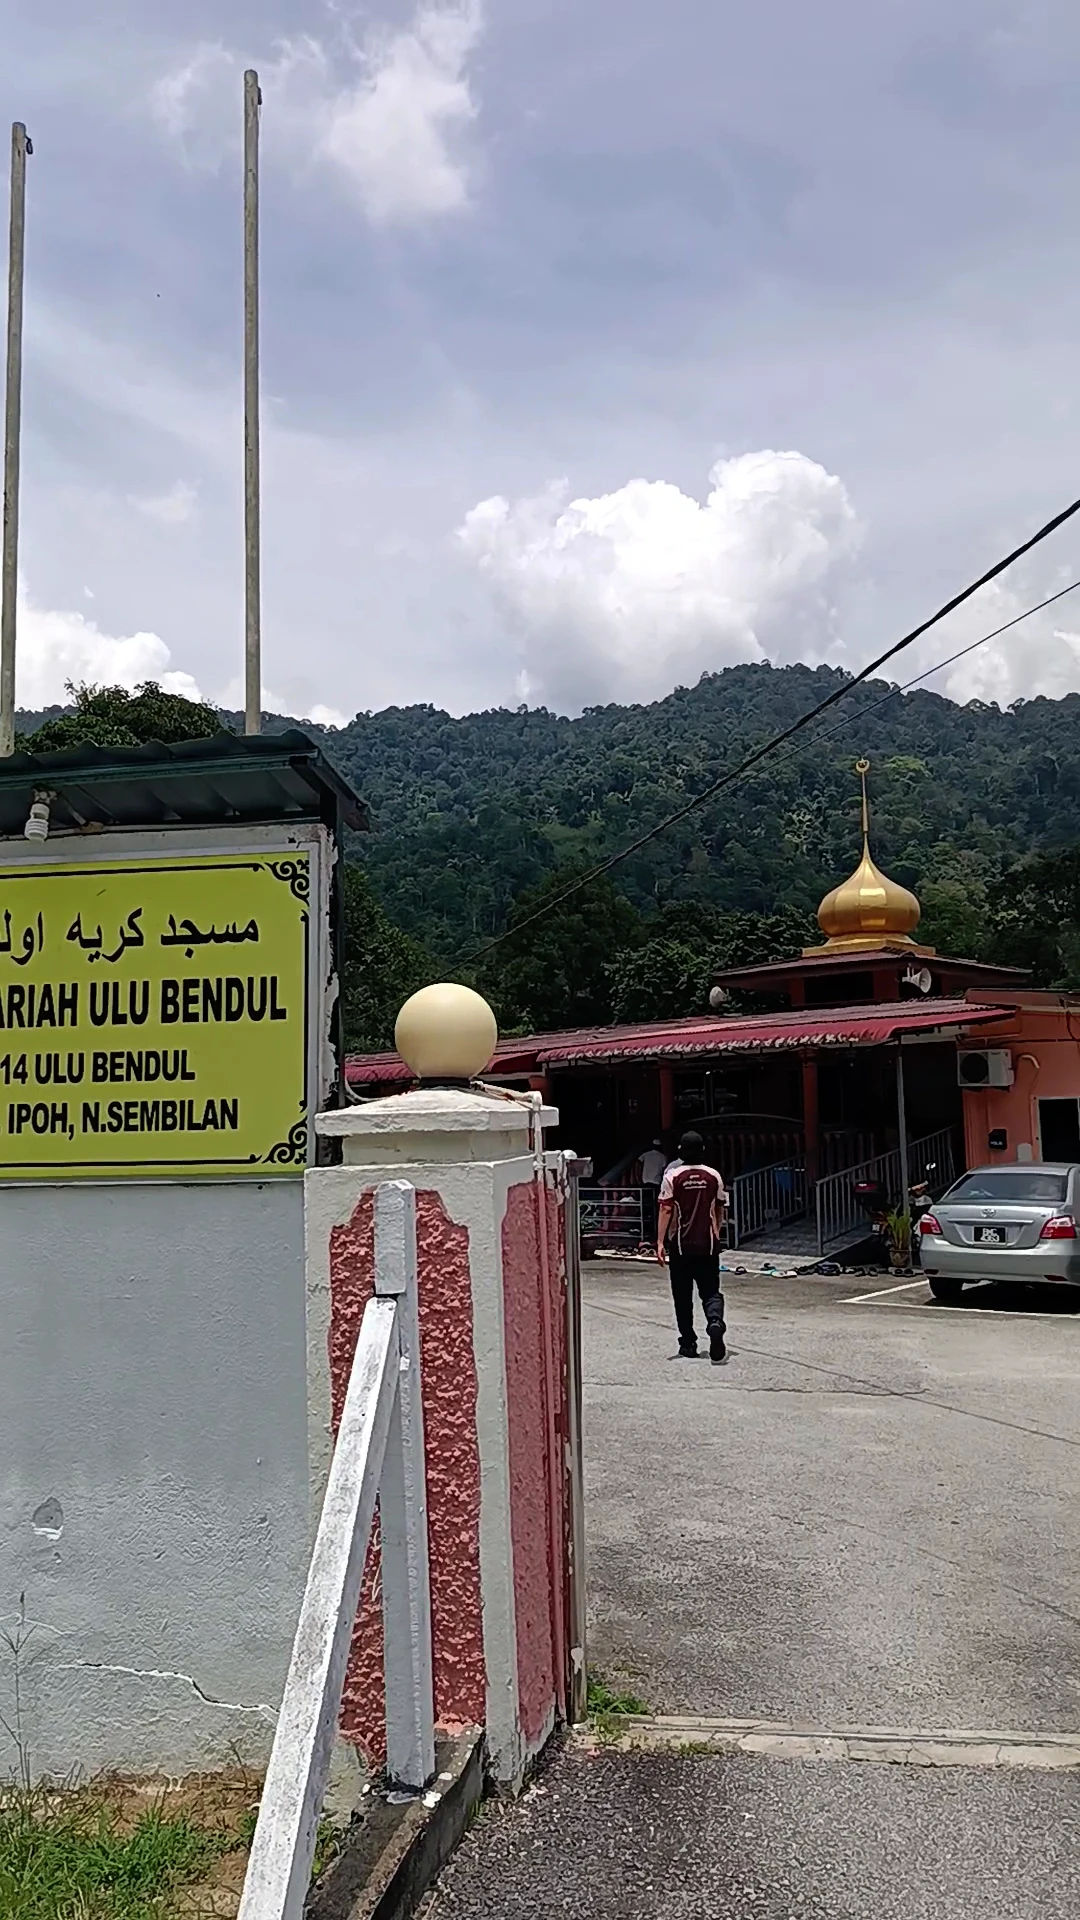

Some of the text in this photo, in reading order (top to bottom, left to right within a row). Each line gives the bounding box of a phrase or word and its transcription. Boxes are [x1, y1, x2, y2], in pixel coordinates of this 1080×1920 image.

[161, 913, 259, 959] مسجد
[0, 975, 287, 1029] RIAH ULU BENDUL
[0, 1049, 196, 1085] 14 ULU BENDUL
[8, 1098, 239, 1140] IPOH, N.SEMBILAN
